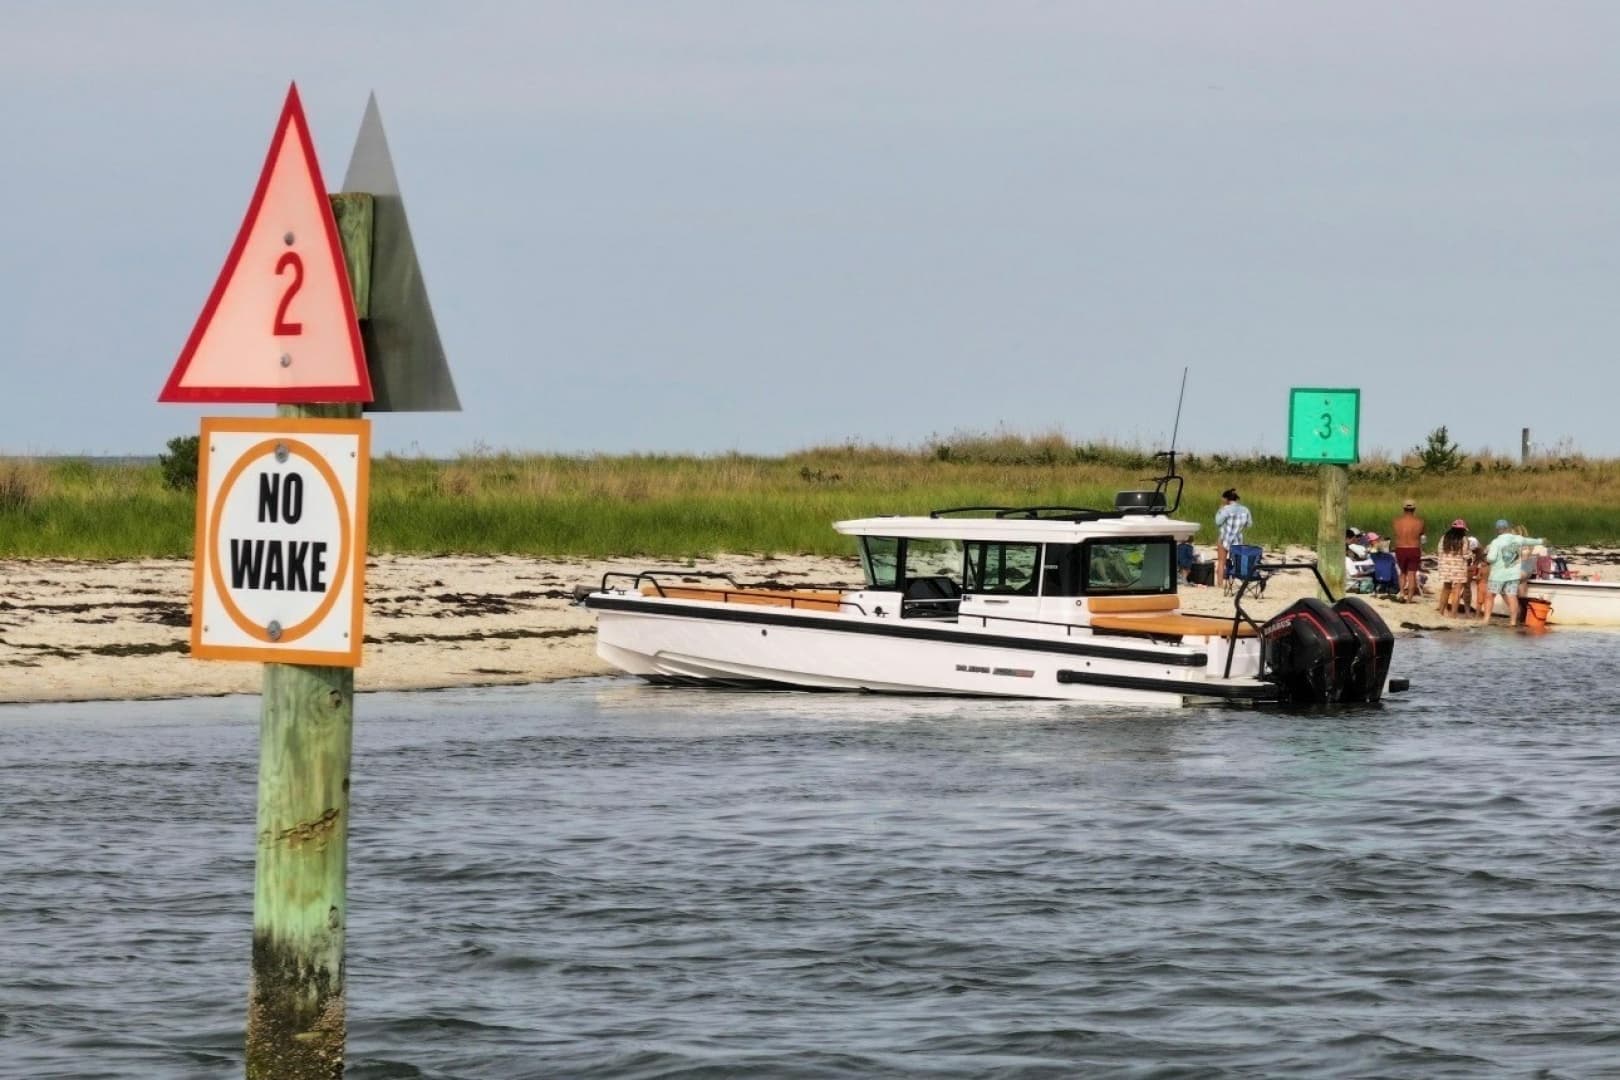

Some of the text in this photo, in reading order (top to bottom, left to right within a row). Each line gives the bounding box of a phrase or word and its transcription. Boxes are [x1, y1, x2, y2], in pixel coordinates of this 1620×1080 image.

[273, 250, 304, 336] 2
[1319, 412, 1332, 440] 3
[258, 472, 304, 525] NO
[230, 538, 327, 593] WAKE
